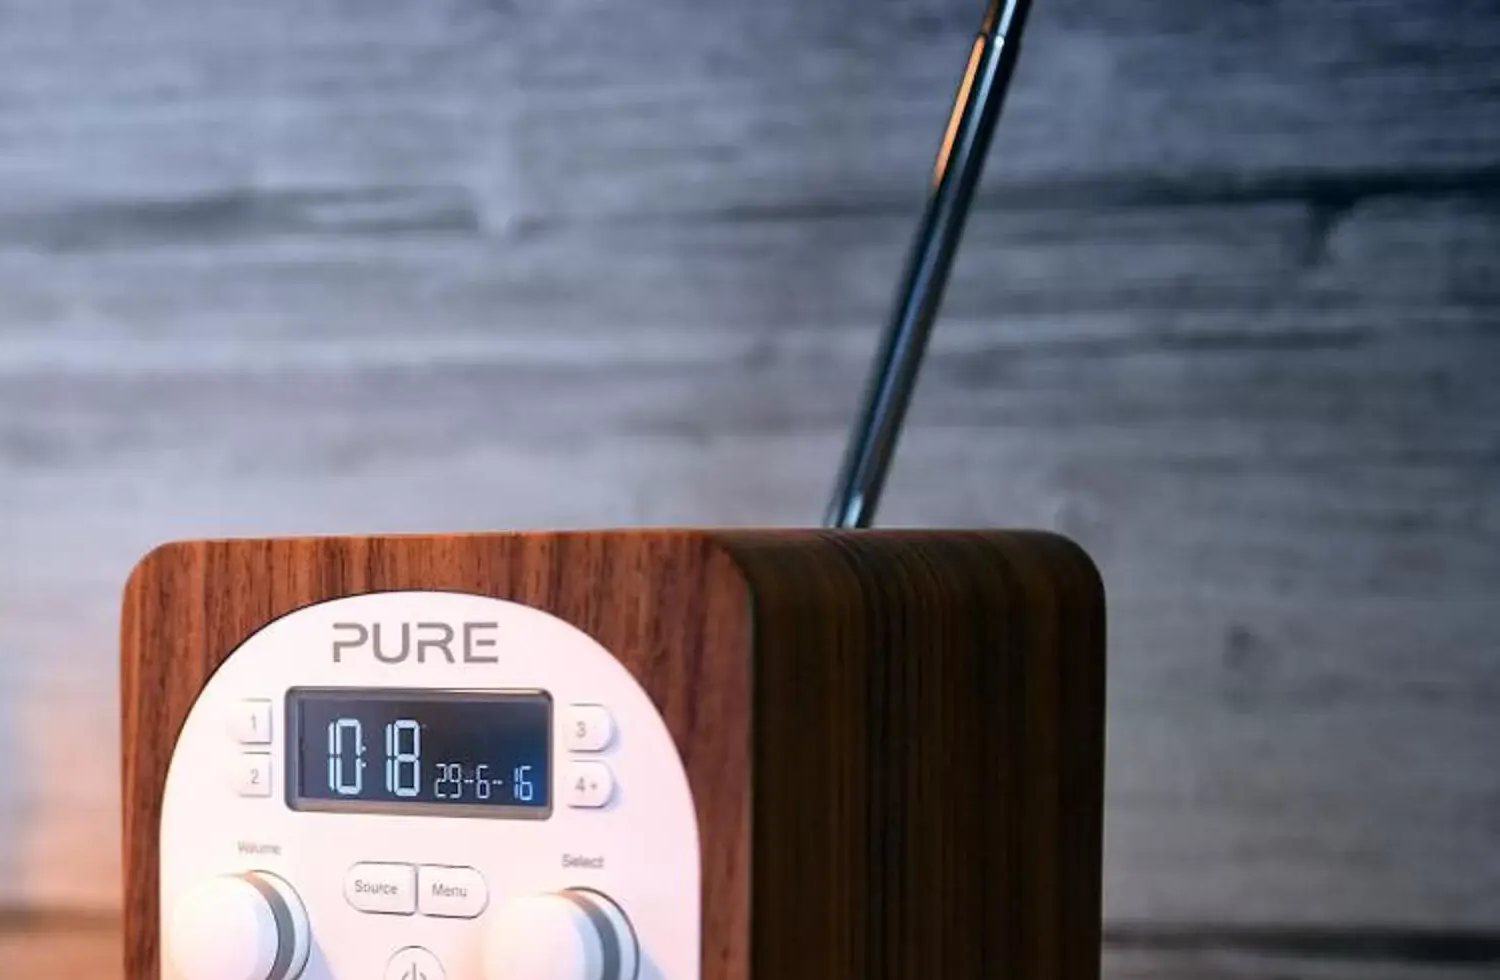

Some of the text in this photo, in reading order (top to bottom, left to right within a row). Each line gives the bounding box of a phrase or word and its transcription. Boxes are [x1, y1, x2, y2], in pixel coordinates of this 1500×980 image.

[333, 623, 499, 664] PURE
[250, 713, 257, 731] 1
[576, 720, 587, 739] 3
[250, 768, 260, 785] 2
[238, 841, 282, 855] Volume
[562, 854, 605, 869] Select
[354, 879, 398, 895] Source
[431, 882, 469, 897] Menu
